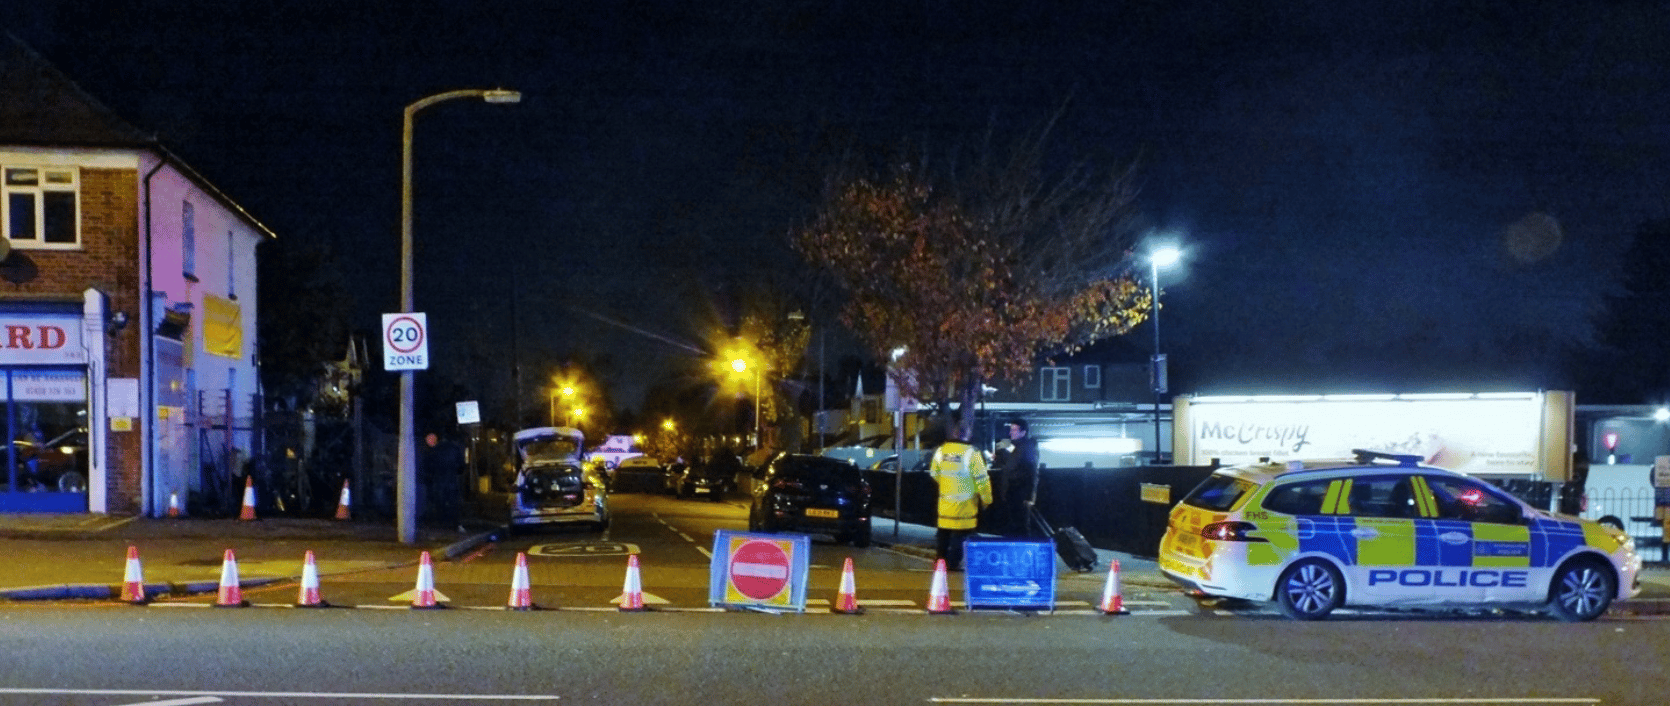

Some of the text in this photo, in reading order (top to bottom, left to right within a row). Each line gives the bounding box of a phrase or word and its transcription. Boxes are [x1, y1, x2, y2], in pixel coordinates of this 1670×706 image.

[0, 325, 67, 350] RD
[392, 327, 418, 342] 20
[389, 355, 424, 366] ZONE
[1200, 420, 1311, 453] McCrispy
[1246, 511, 1268, 520] FHS
[1368, 569, 1529, 587] POLICE
